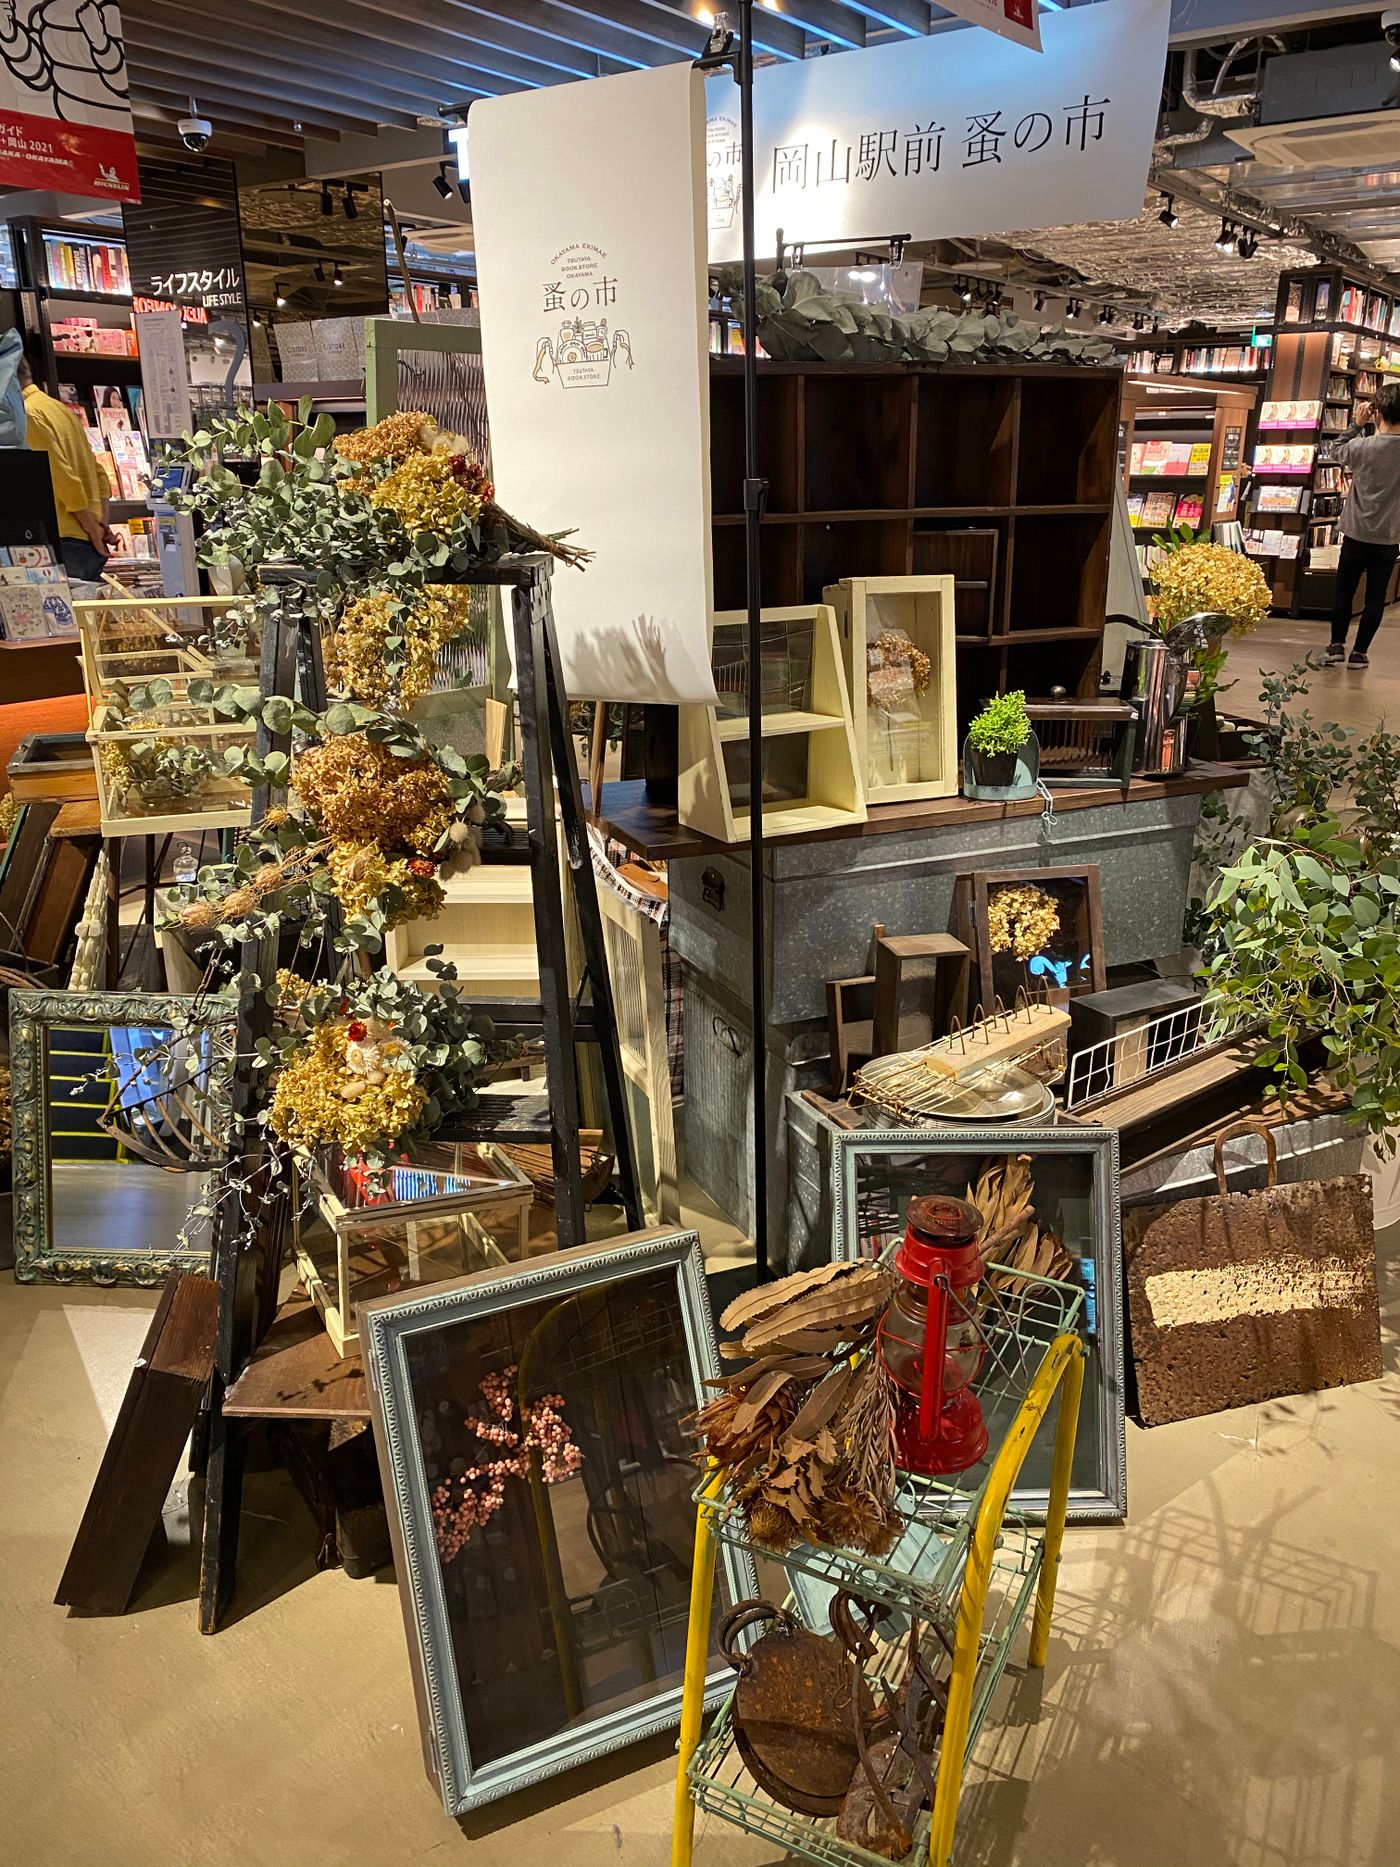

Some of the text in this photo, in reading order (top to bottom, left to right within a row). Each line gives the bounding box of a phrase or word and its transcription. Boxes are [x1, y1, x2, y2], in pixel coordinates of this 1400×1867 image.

[29, 140, 53, 154] 2021
[773, 94, 1112, 194] 岡山駅前 蚤の市
[94, 180, 130, 191] MICHELIN
[550, 243, 608, 265] OKAYAMA EKIMAE
[567, 256, 591, 264] TSUTAYA
[150, 268, 240, 296] ライフスタイル
[566, 271, 593, 279] OKAYAMA
[542, 276, 619, 313] 蚤の市
